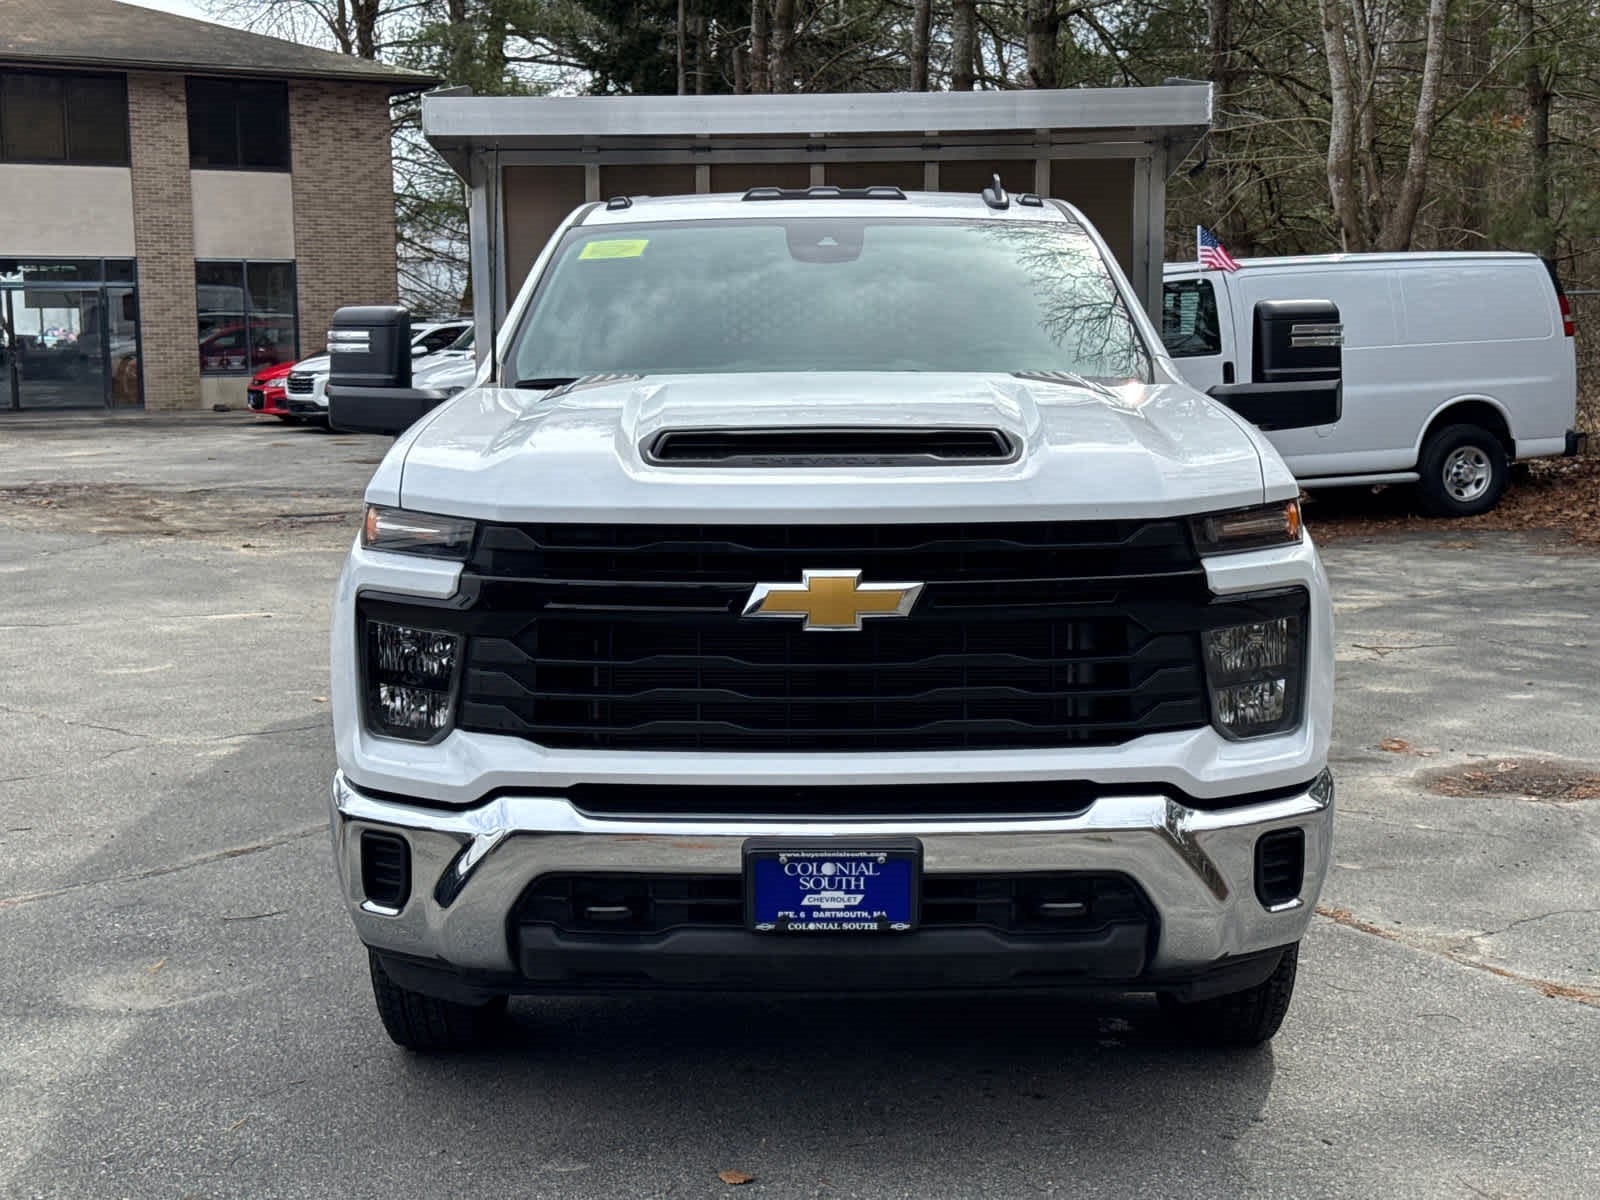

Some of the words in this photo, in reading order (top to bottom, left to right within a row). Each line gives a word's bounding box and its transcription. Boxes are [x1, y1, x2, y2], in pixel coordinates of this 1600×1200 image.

[785, 862, 880, 876] COLONIAL
[799, 877, 865, 890] SOUTH
[808, 896, 857, 904] CHEVROLET
[813, 911, 871, 919] DARTMOUTH,
